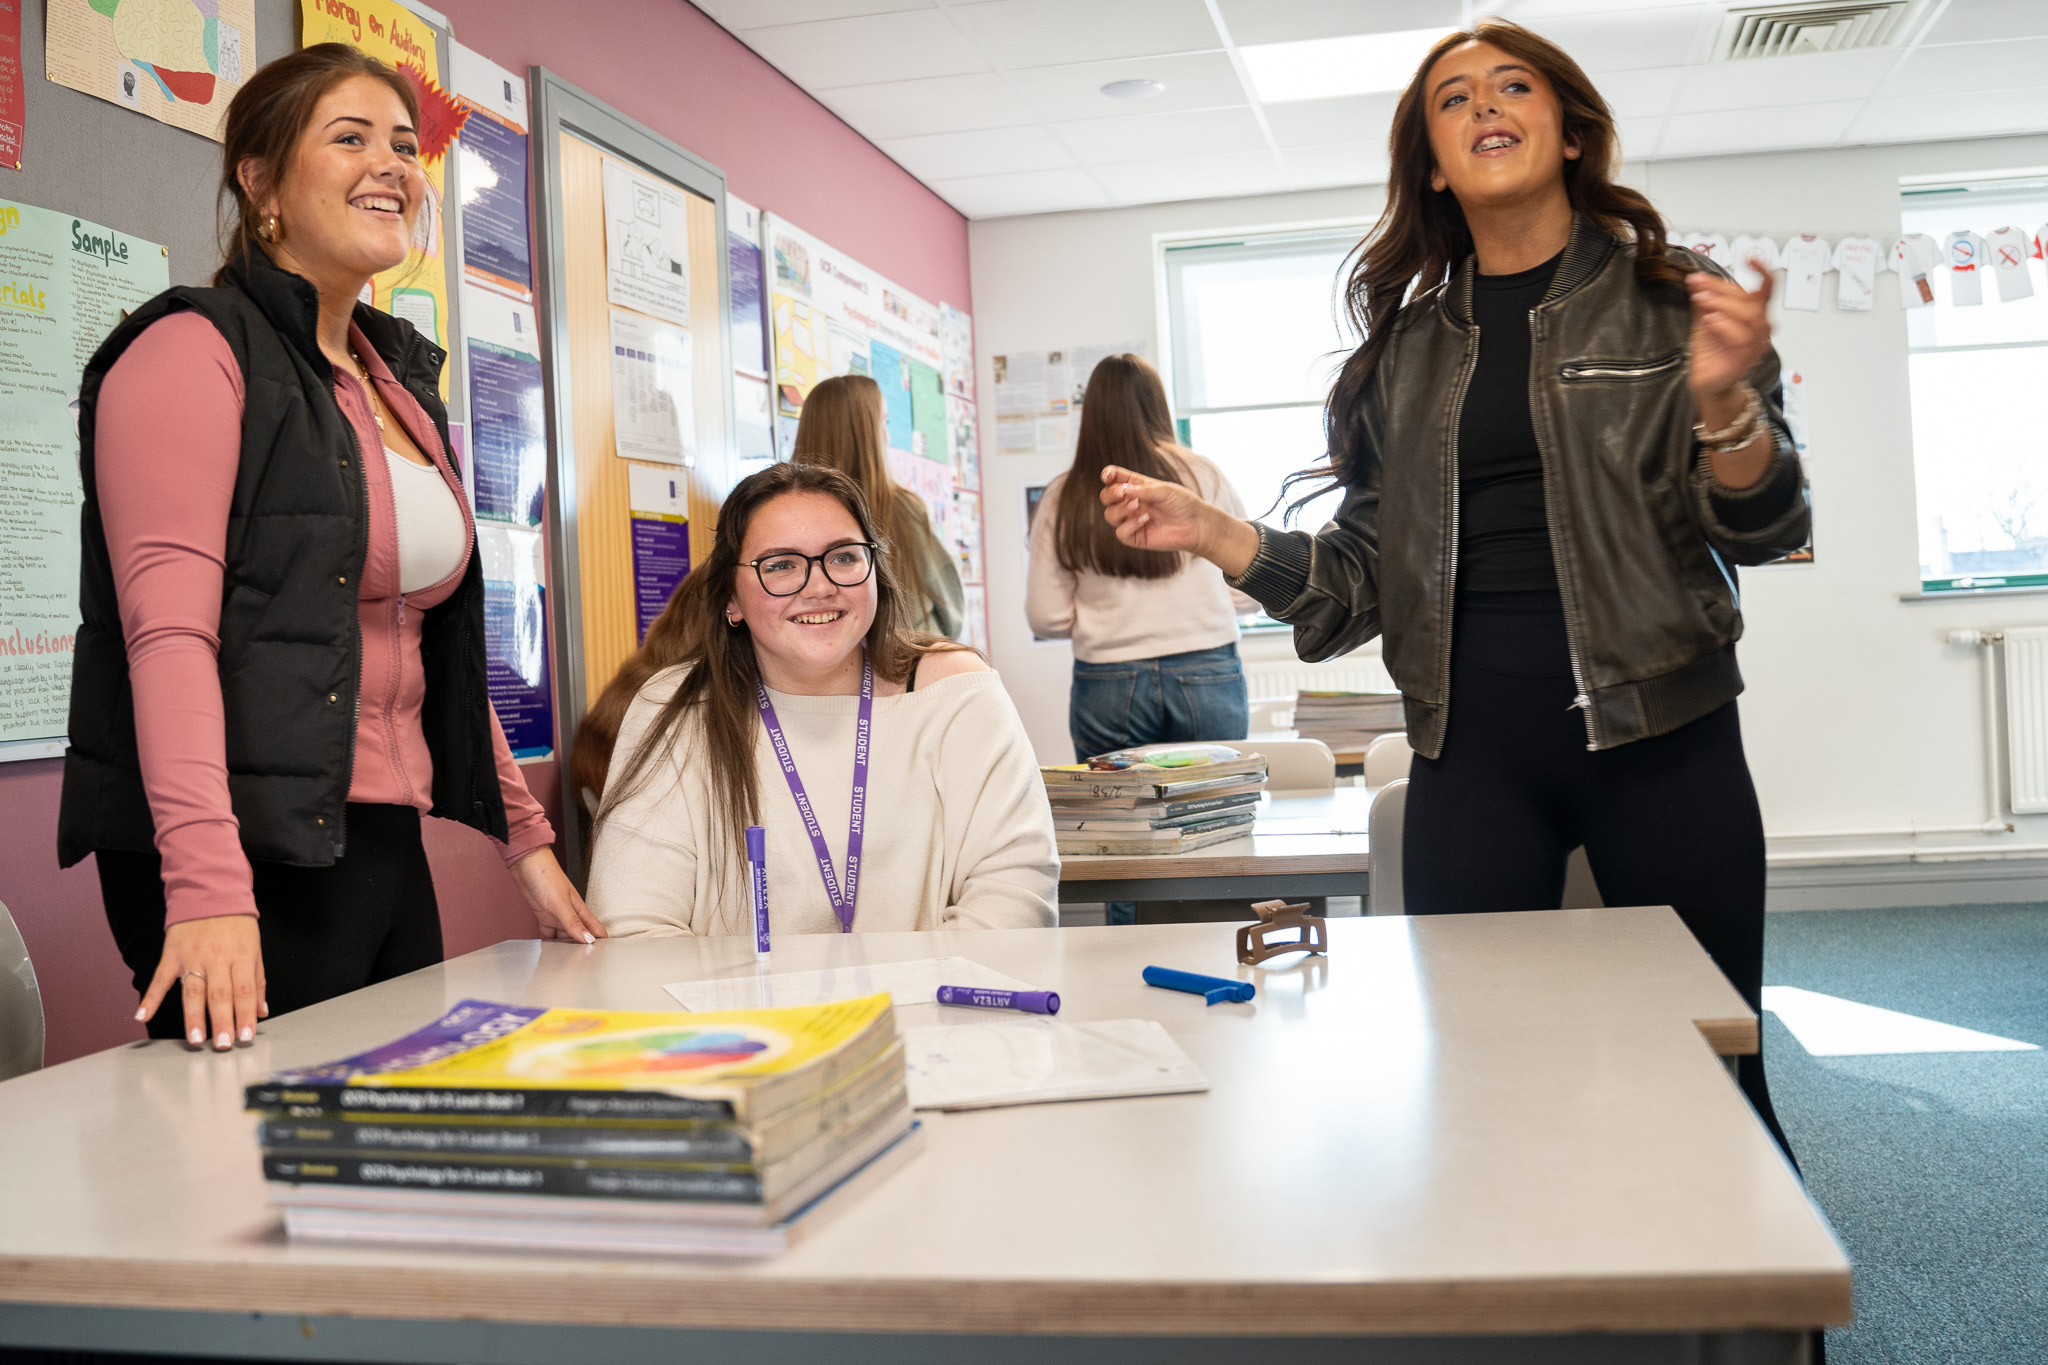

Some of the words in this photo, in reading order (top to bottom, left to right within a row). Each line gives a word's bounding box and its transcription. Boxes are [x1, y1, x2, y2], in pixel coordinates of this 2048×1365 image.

[72, 219, 129, 267] Sample
[770, 728, 795, 773] STUDENT
[856, 718, 869, 766] STUDENT
[795, 792, 821, 838] STUDENT
[851, 786, 864, 835] STUDENT
[820, 857, 843, 907] STUDENT
[845, 855, 858, 907] STUDENT
[972, 995, 1011, 1007] ARTEZA
